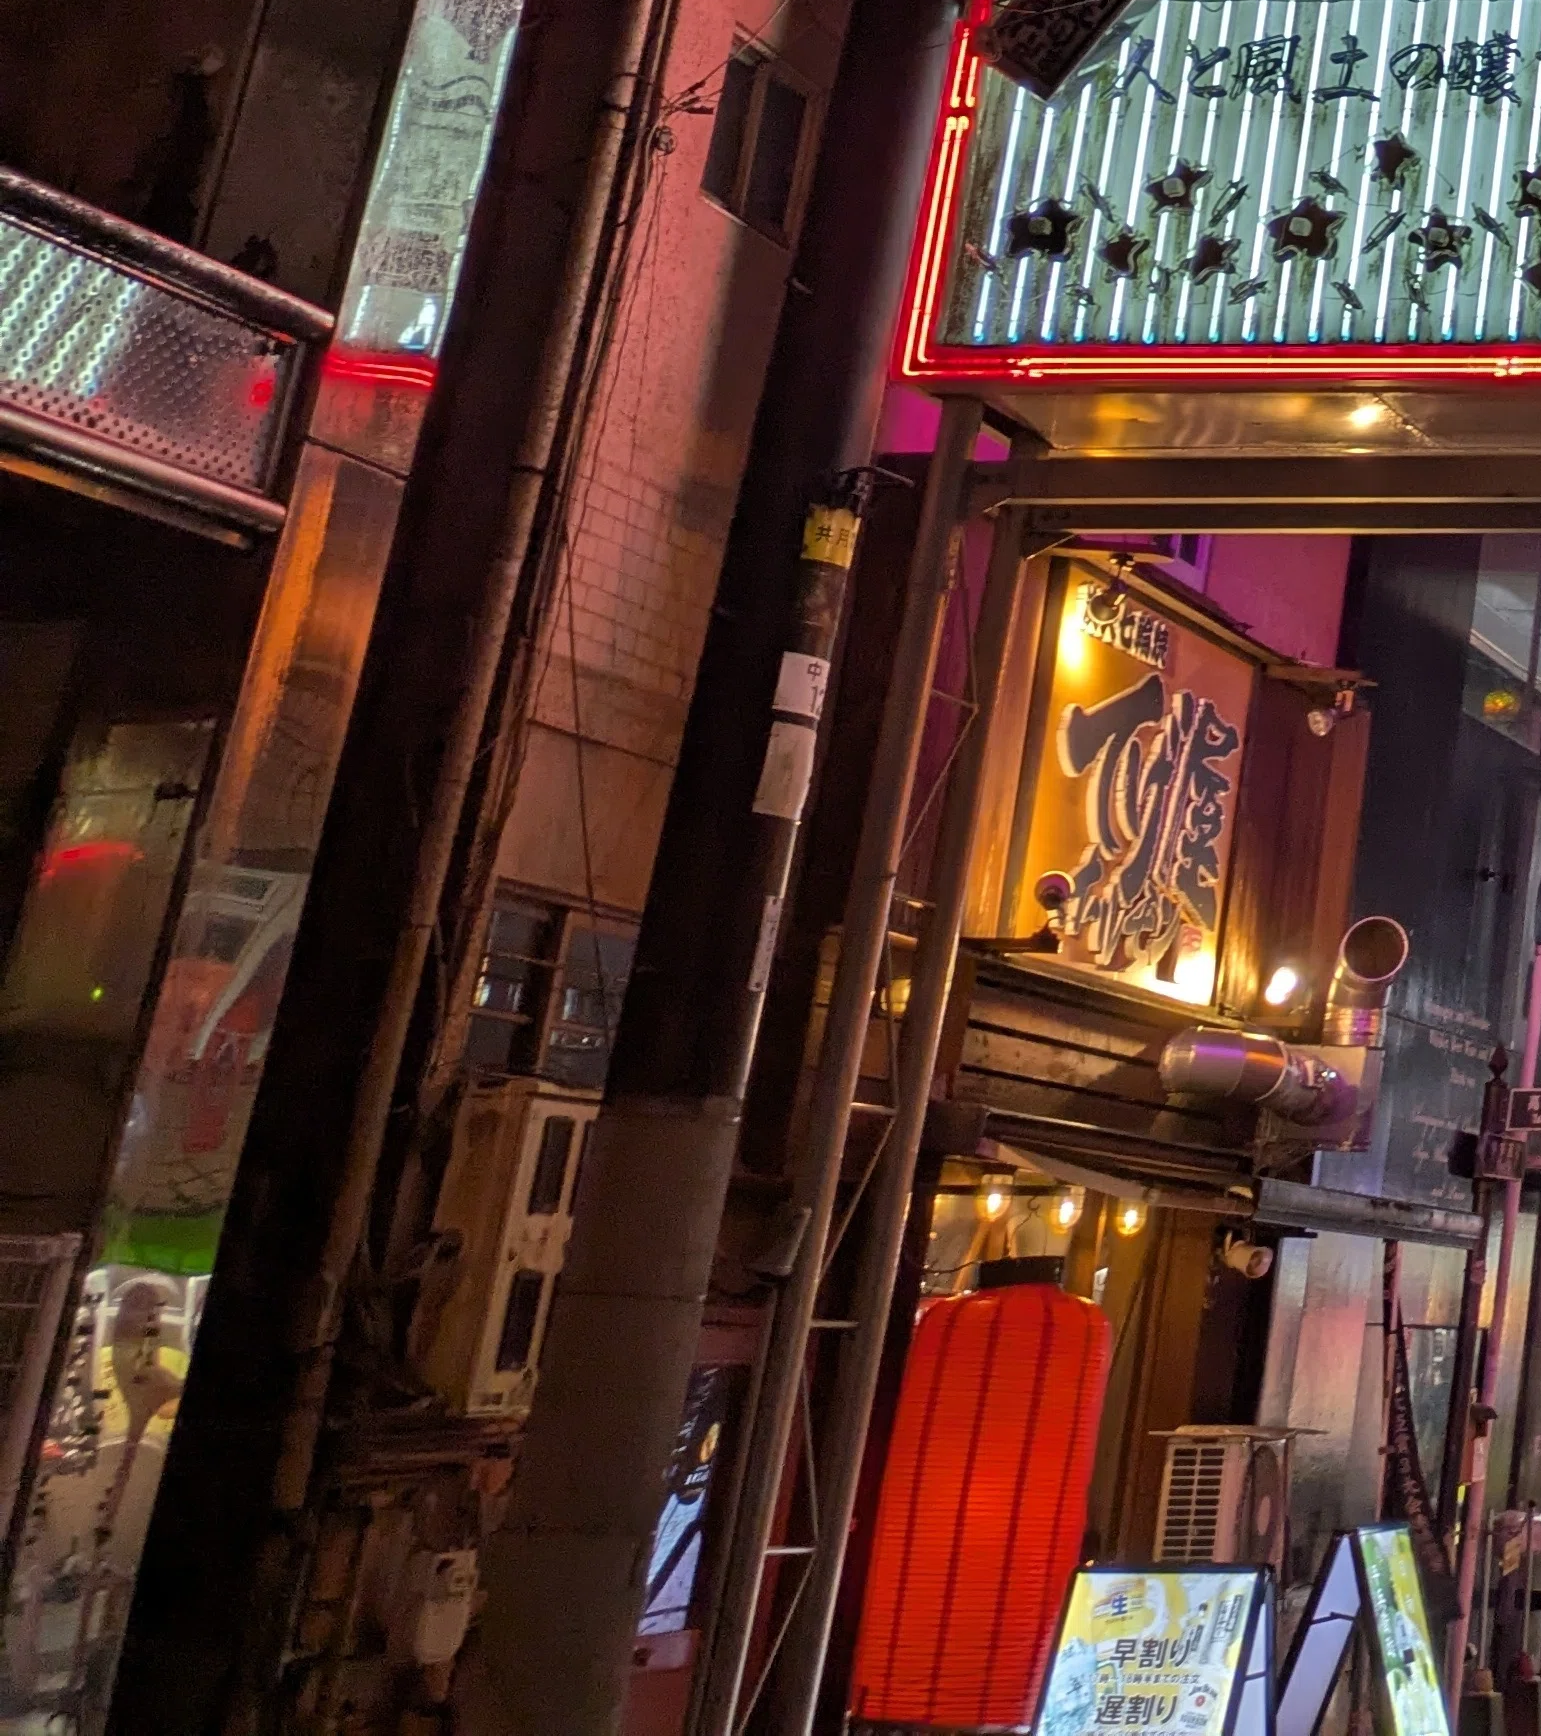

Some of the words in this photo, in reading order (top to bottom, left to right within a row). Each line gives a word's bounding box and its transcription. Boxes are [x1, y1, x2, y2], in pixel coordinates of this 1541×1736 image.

[1109, 1637, 1192, 1669] 早割り
[1094, 1694, 1178, 1725] 遅割り
